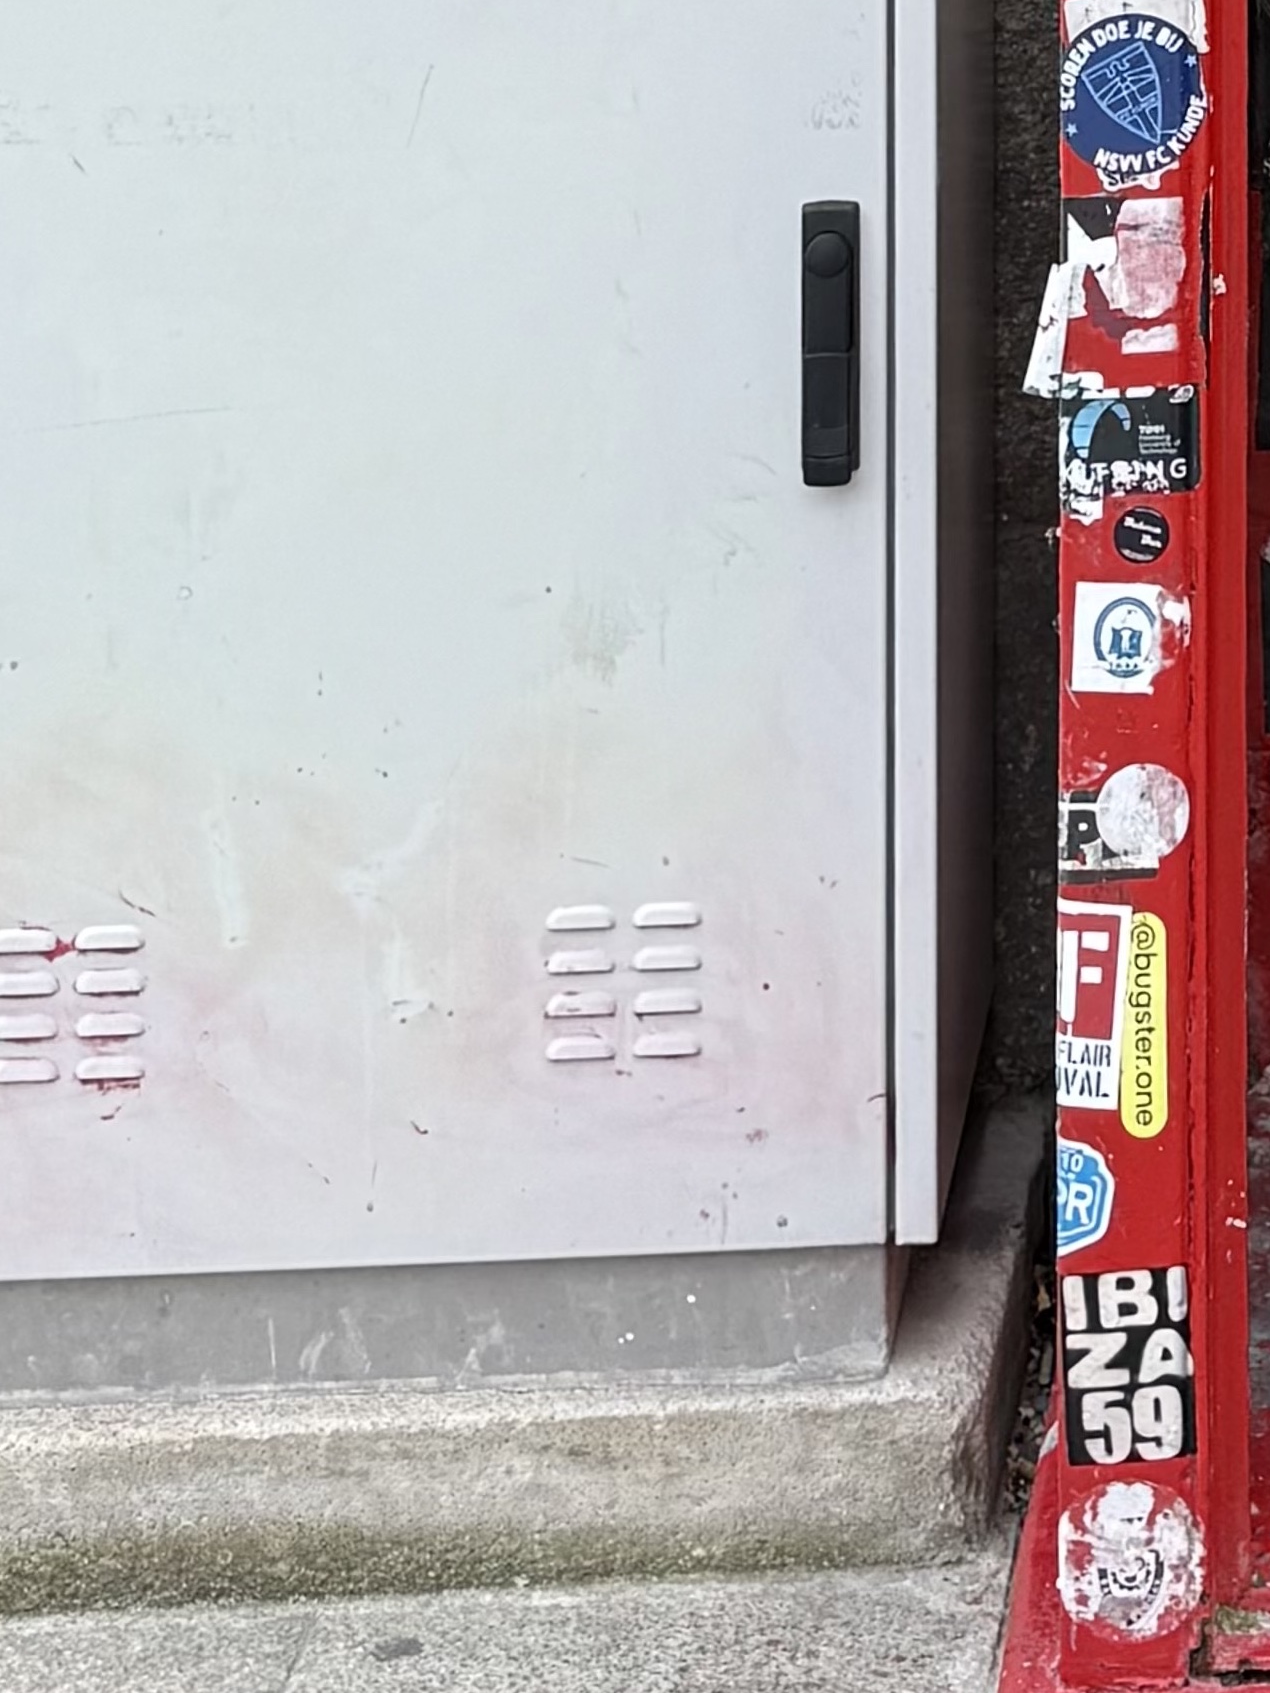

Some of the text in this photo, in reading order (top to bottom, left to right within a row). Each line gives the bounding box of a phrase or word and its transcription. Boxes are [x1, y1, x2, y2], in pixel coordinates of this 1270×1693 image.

[1060, 42, 1097, 112] SCOREN
[1091, 19, 1133, 48] DOE
[1133, 18, 1155, 41] JE
[1127, 921, 1158, 1127] @bugster.one
[1062, 1265, 1188, 1332] IBI
[1066, 1328, 1195, 1391] ZA
[1081, 1384, 1184, 1465] 59
